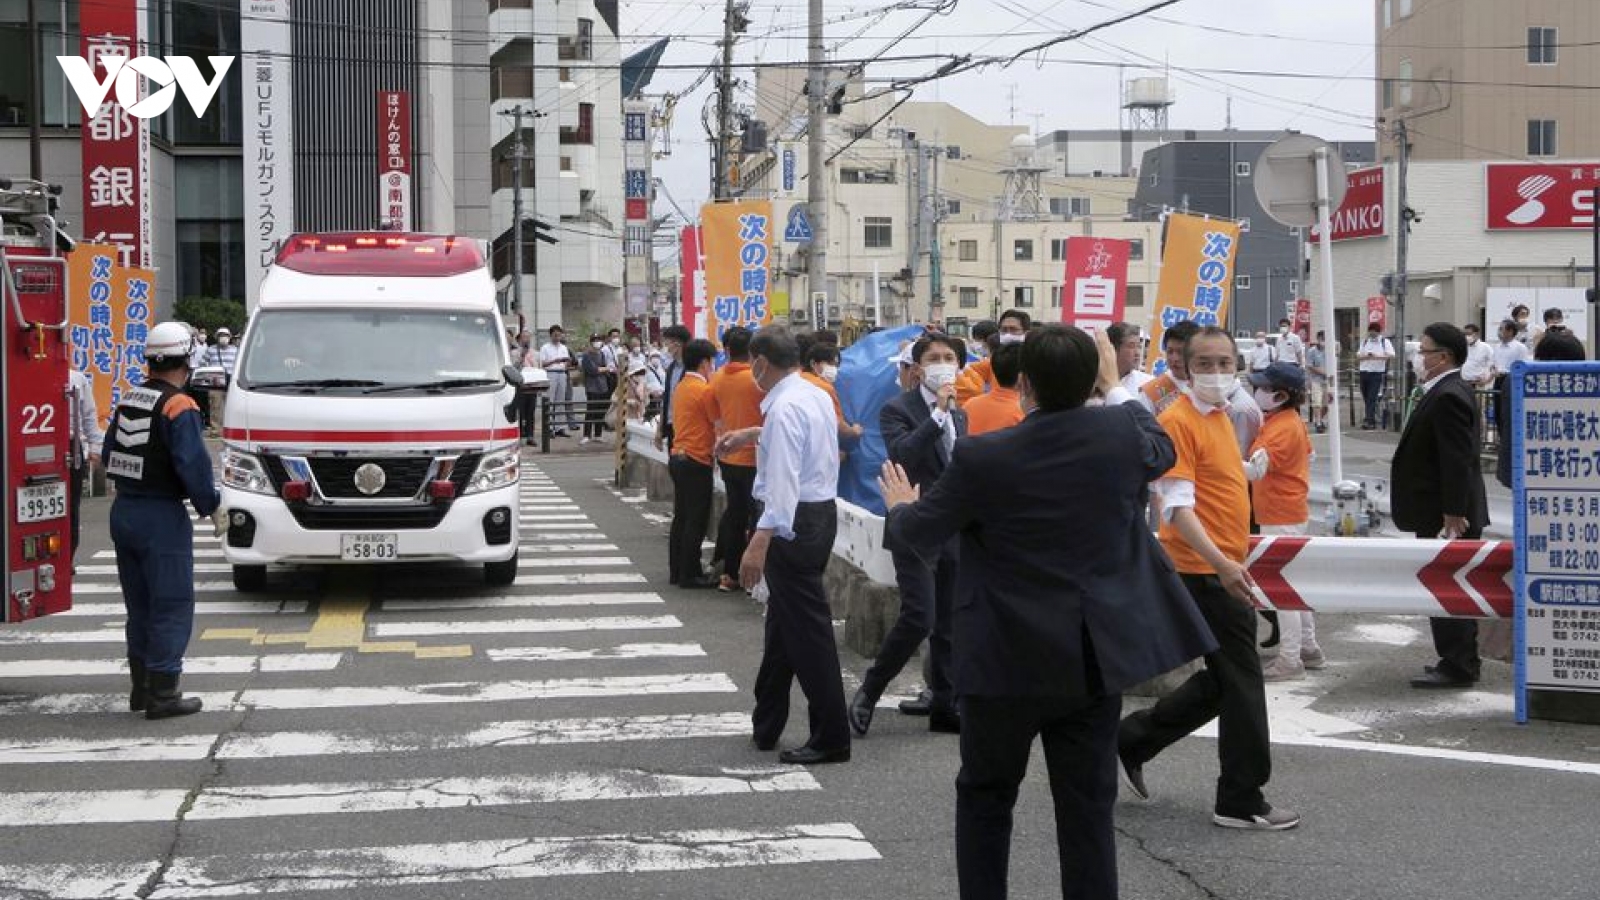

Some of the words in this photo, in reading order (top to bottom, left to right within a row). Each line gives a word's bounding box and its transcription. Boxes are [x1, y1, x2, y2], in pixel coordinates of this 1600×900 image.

[1328, 204, 1383, 233] ANKO
[91, 255, 113, 374] 次の時代を
[21, 404, 55, 434] 22
[28, 496, 64, 517] 99-95
[353, 543, 394, 558] 58-03
[1565, 549, 1598, 570] 22:00
